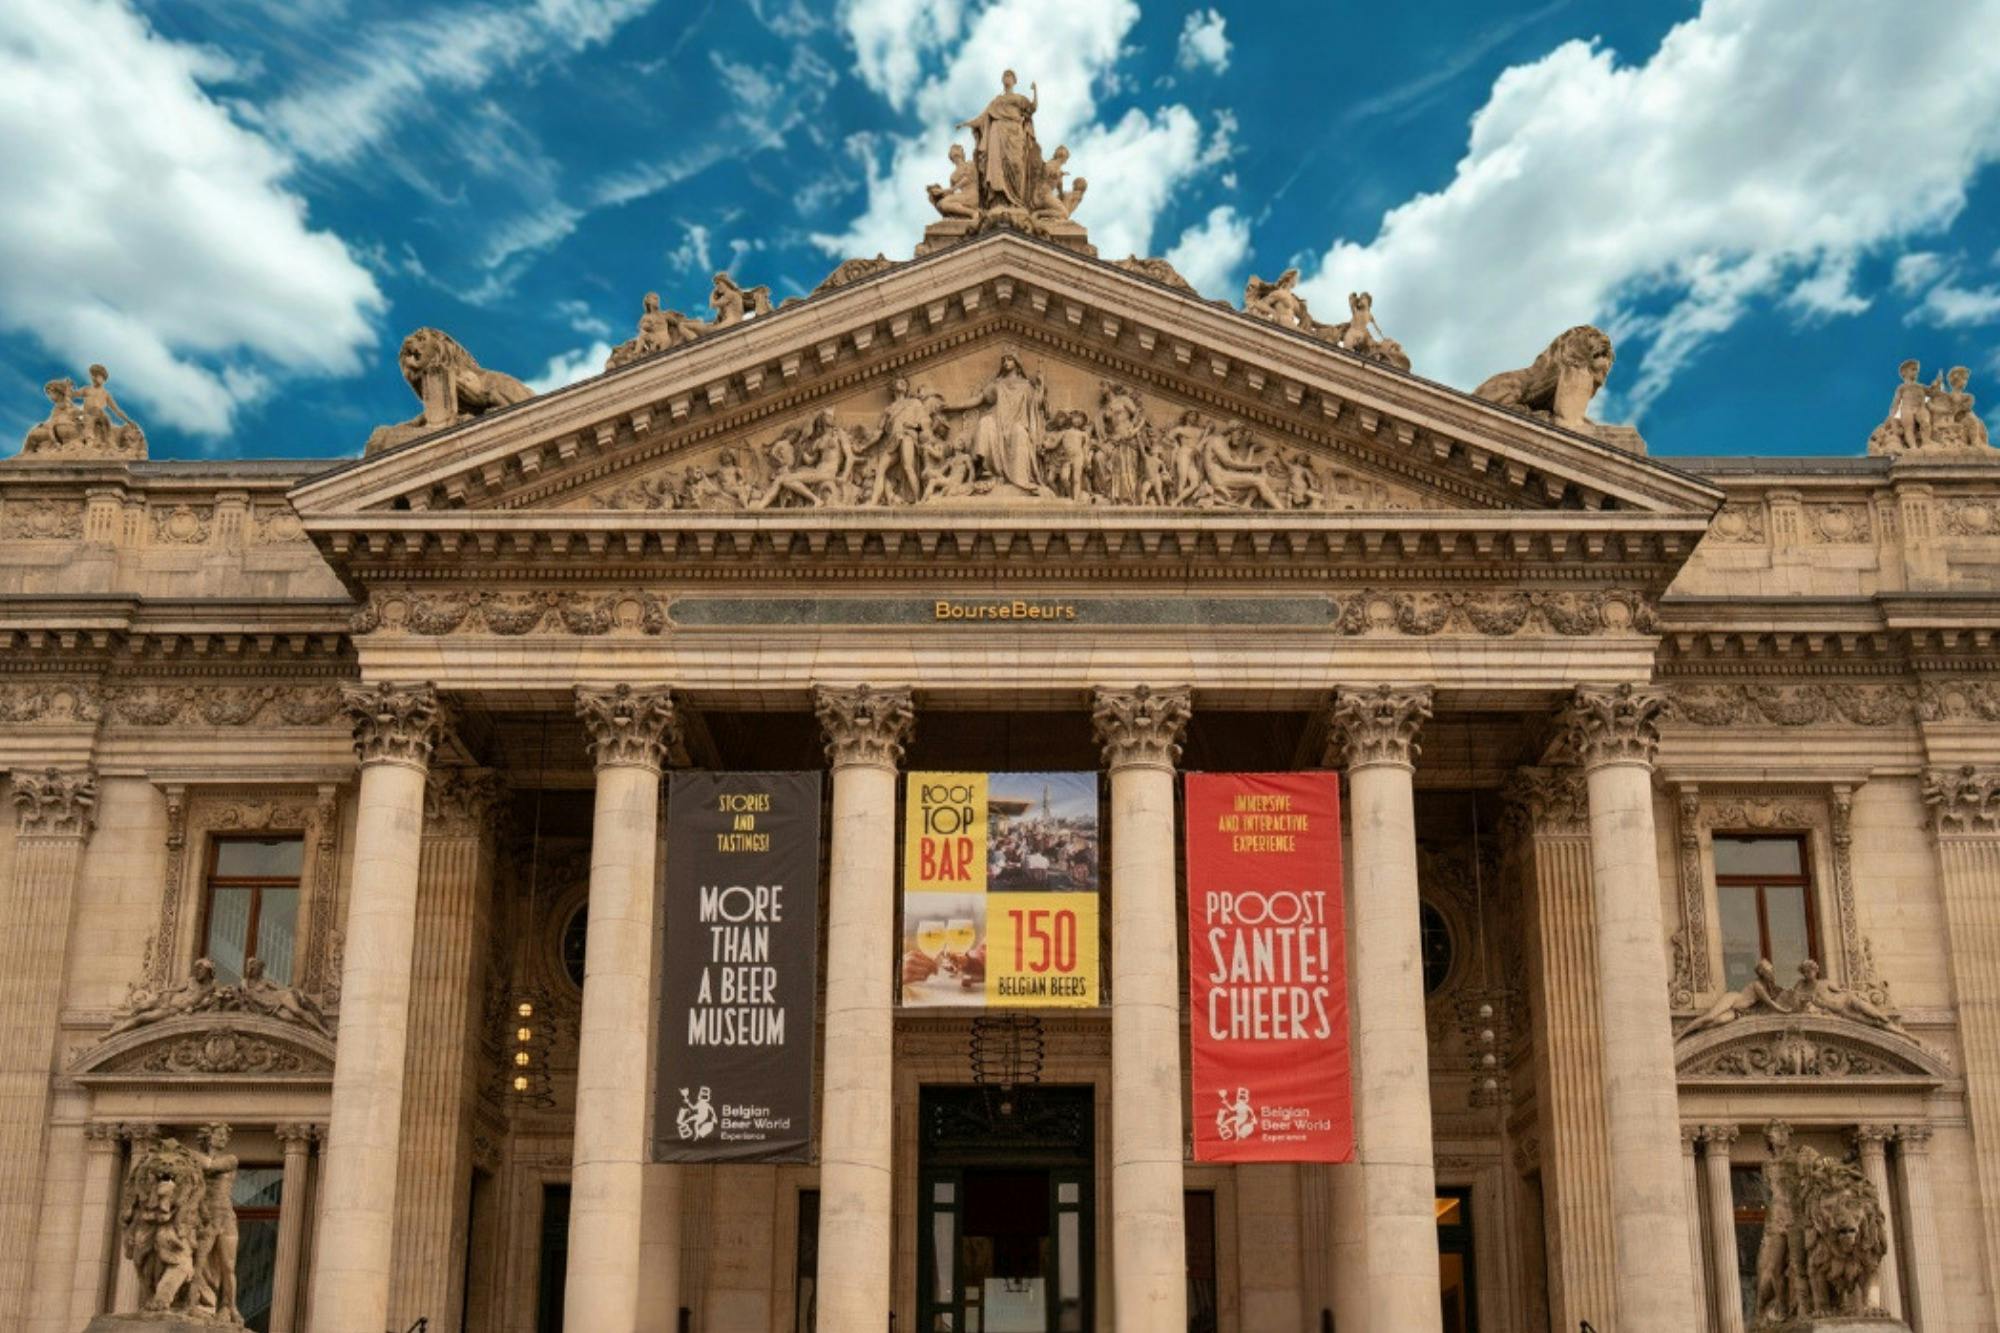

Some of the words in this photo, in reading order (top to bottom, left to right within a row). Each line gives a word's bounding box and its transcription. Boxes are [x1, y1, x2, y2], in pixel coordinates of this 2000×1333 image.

[935, 601, 1075, 619] BourseBeurs
[719, 794, 769, 811] STORIES
[921, 784, 975, 804] ROOF
[1234, 795, 1291, 812] IMMERSIVE
[734, 814, 754, 830] AND
[921, 806, 974, 835] TOP
[1219, 815, 1239, 832] AND
[1243, 814, 1308, 831] INTERACTIVE
[717, 833, 769, 851] TASTINGS!
[1233, 835, 1295, 852] EXPERIENCE
[920, 837, 974, 881] BAR
[700, 885, 783, 922] MORE
[1206, 891, 1326, 925] PROOST
[710, 926, 769, 963] THAN
[1008, 909, 1077, 973] 150
[1208, 922, 1329, 984] SANTÉ!
[698, 966, 712, 1004] A
[720, 966, 778, 1004] BEER
[999, 976, 1046, 996] BELGIAN
[1050, 976, 1086, 997] BEERS
[1209, 986, 1330, 1040] CHEERS
[688, 1007, 785, 1045] MUSEUM
[722, 1104, 770, 1119] Belgian
[1261, 1106, 1310, 1121] Belgian
[721, 1118, 751, 1129] Beer
[753, 1118, 791, 1129] World
[1262, 1119, 1292, 1131] Beer
[1295, 1119, 1331, 1131] World
[721, 1131, 766, 1141] Experience
[1262, 1133, 1307, 1143] Experience
